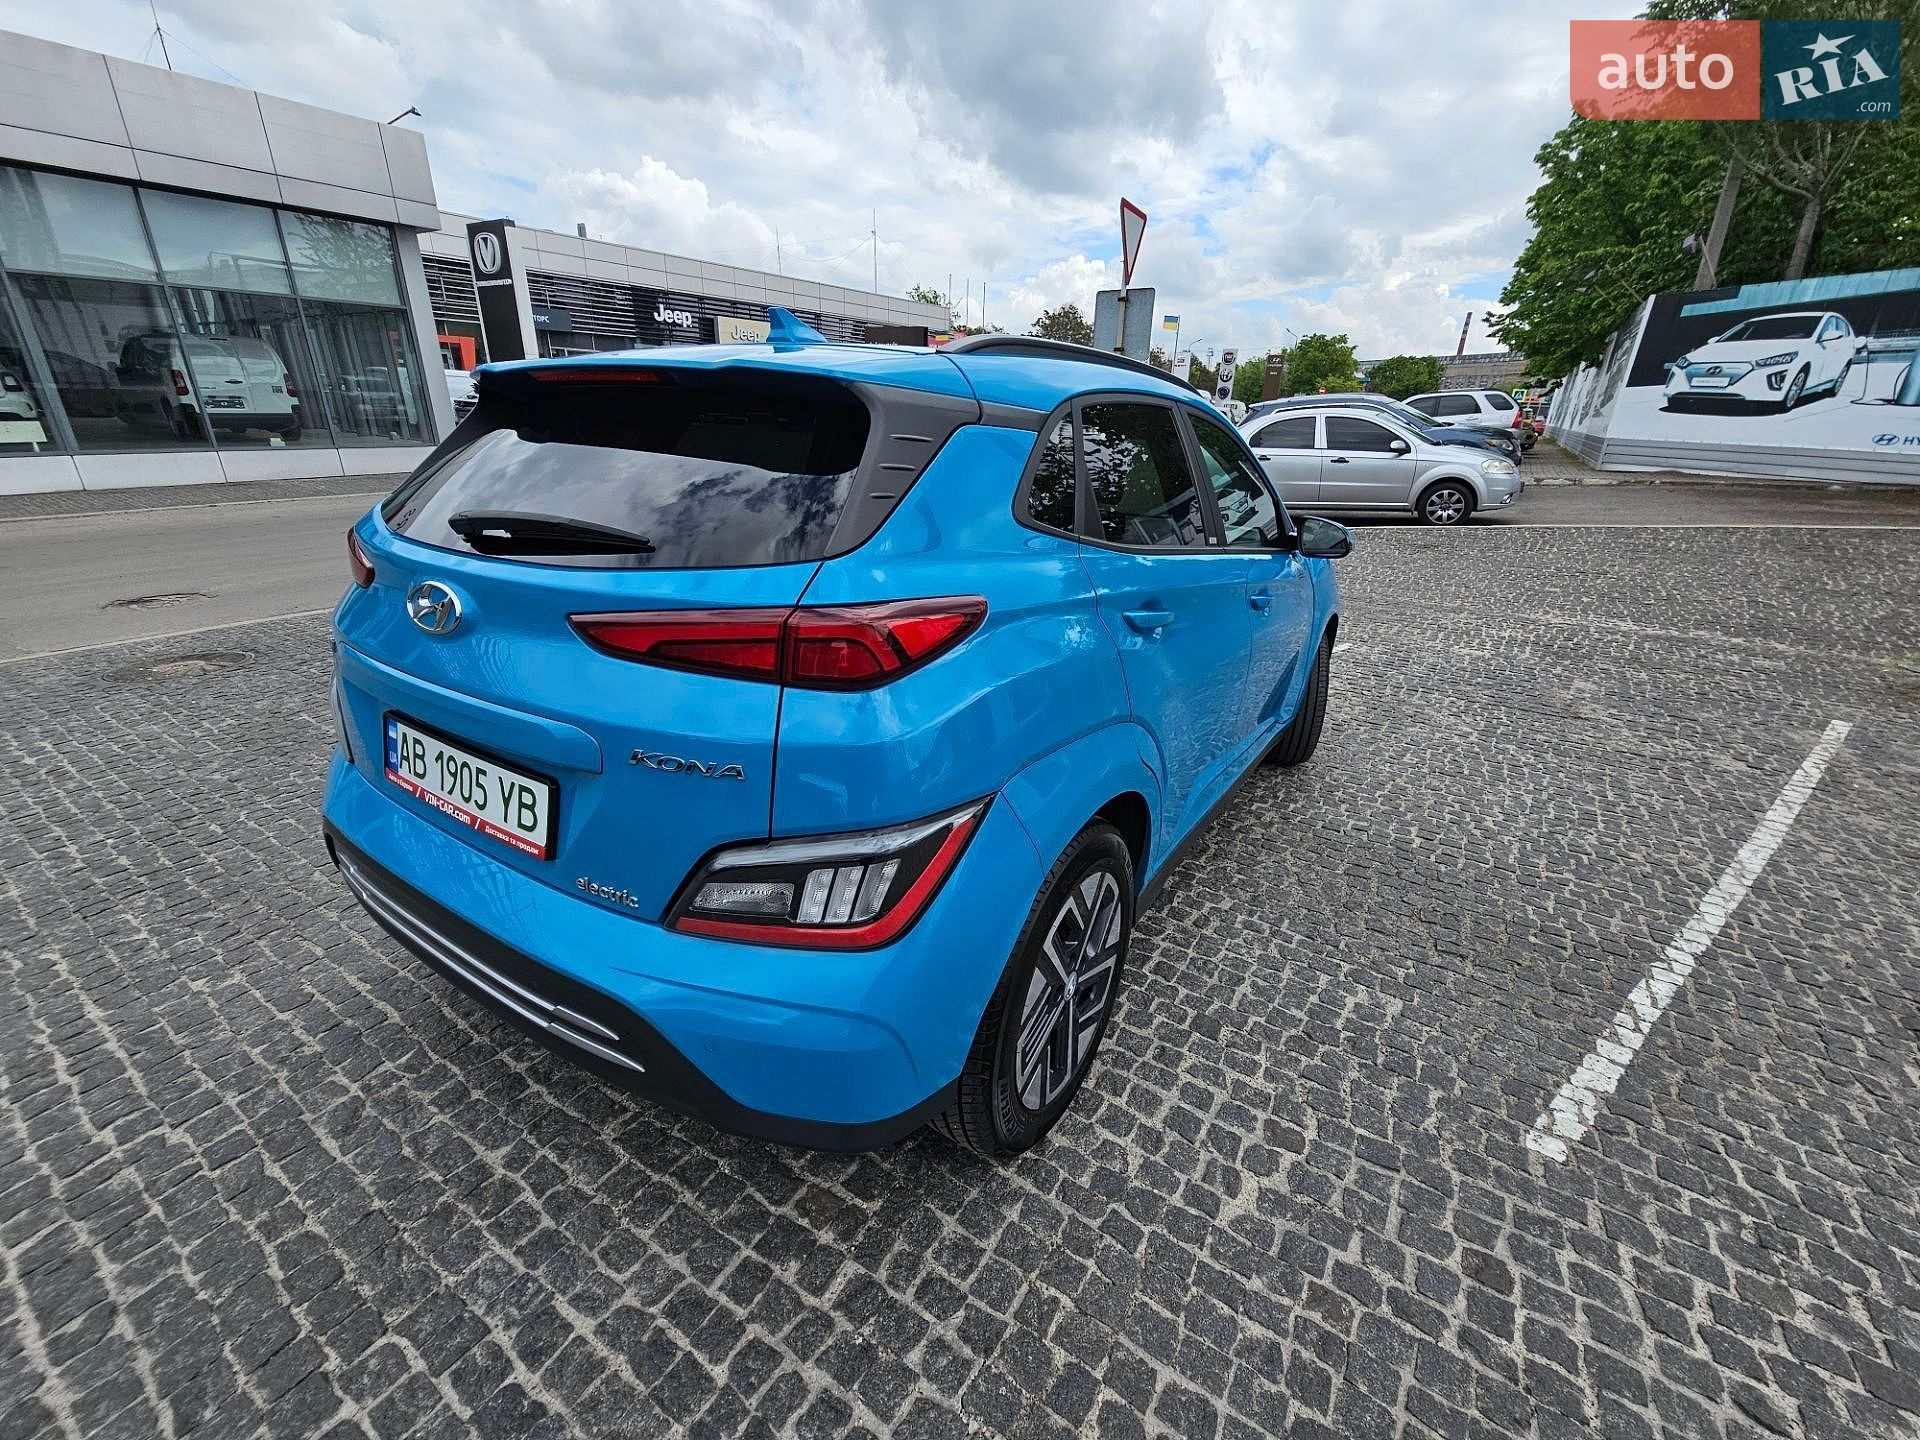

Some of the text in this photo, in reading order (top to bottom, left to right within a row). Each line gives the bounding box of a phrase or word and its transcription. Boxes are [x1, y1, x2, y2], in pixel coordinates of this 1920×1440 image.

[653, 303, 692, 328] Jeep
[731, 324, 760, 343] Jeep
[628, 748, 746, 781] KONA
[399, 731, 538, 833] AB 1905 YB
[423, 791, 471, 825] VIN-CAR.com
[576, 877, 640, 907] electric
